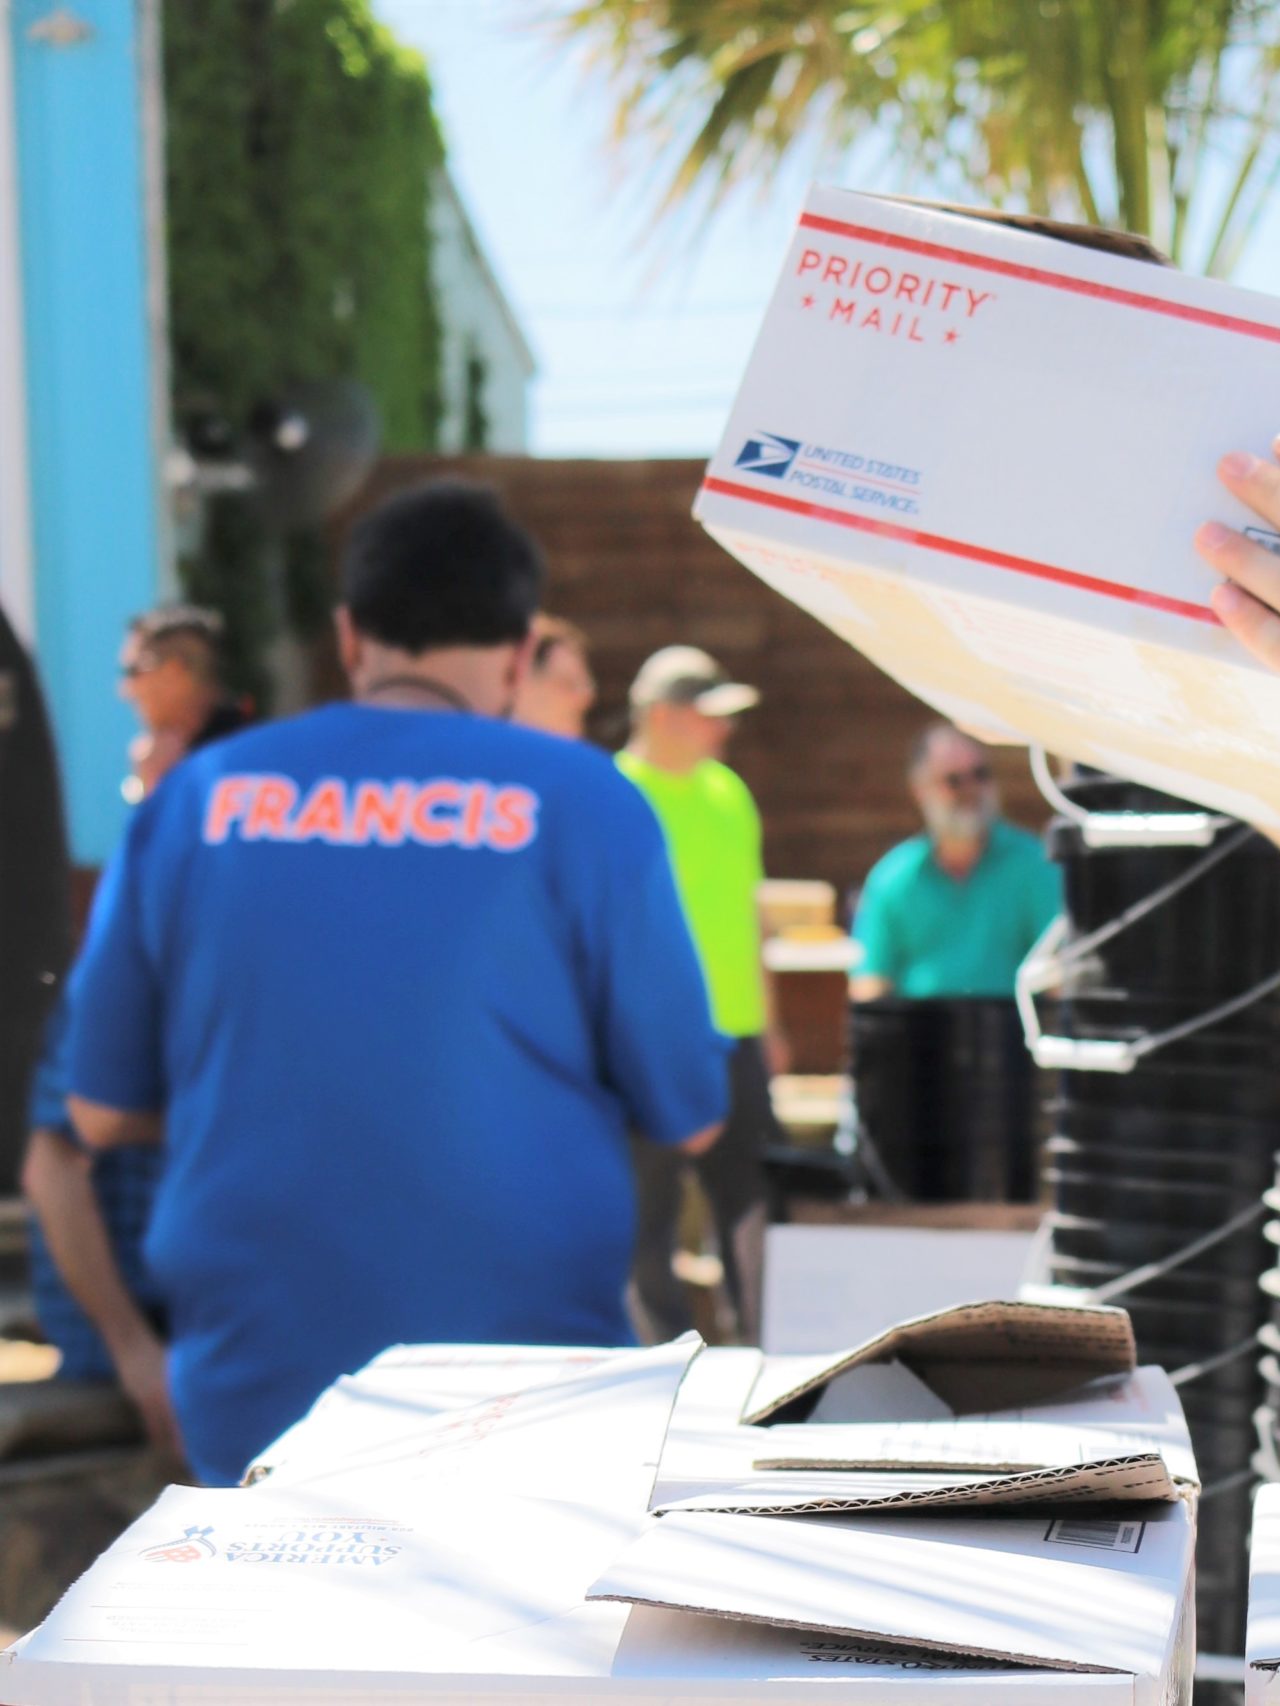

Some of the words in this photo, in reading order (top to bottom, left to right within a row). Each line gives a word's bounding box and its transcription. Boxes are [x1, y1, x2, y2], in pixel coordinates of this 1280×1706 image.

[796, 249, 989, 318] PRIORITY
[830, 298, 924, 342] MAIL
[803, 445, 865, 470] UNITED
[866, 459, 922, 485] STATES
[788, 470, 846, 495] POSTAL
[202, 770, 541, 853] FRANCIS
[228, 1541, 402, 1555] SUPPORTS
[279, 1531, 367, 1543] YOU
[226, 1552, 395, 1566] AMERICA
[808, 1654, 895, 1665] STATES
